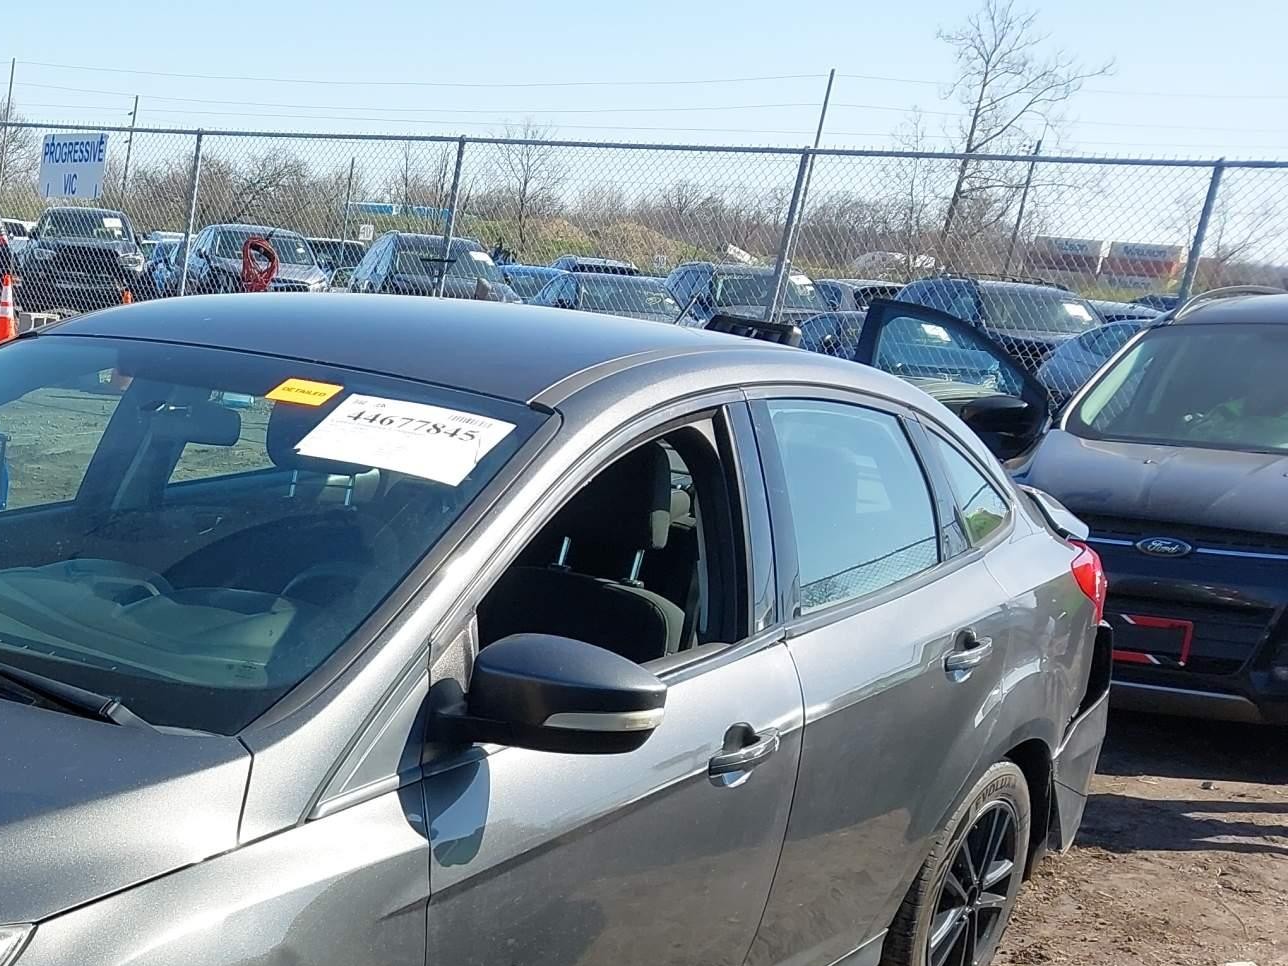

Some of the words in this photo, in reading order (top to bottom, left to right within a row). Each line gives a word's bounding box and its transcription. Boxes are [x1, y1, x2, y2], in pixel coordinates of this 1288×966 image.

[43, 140, 104, 163] PROGRESSIVE
[63, 173, 78, 195] VIC
[282, 386, 327, 397] DETAILED
[347, 409, 479, 441] 44677845
